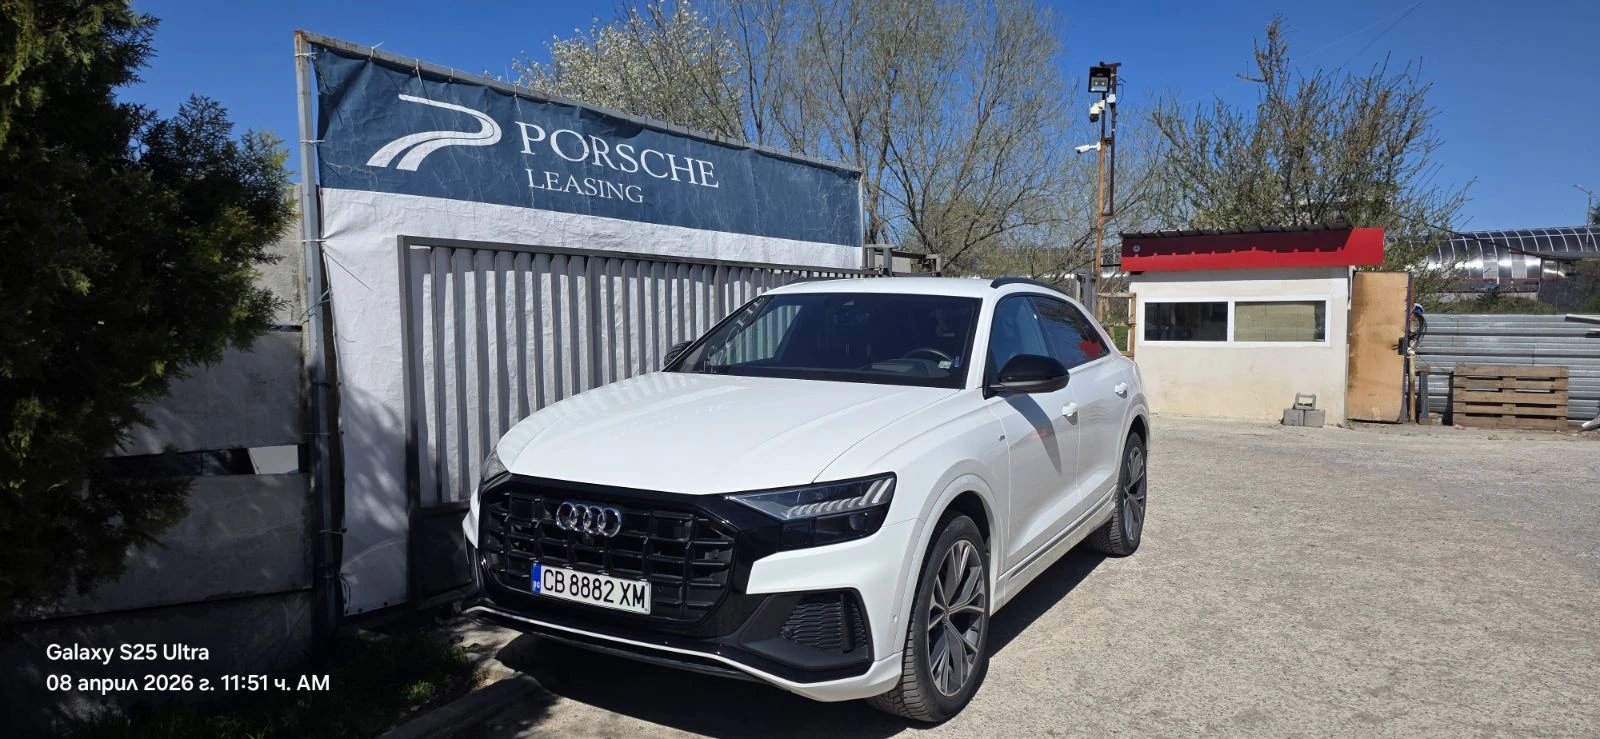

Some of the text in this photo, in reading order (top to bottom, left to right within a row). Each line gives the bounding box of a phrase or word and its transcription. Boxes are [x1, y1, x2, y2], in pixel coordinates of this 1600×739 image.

[514, 121, 719, 188] PORSCHE
[525, 168, 643, 203] LEASING
[544, 569, 645, 608] CB 8882 XM
